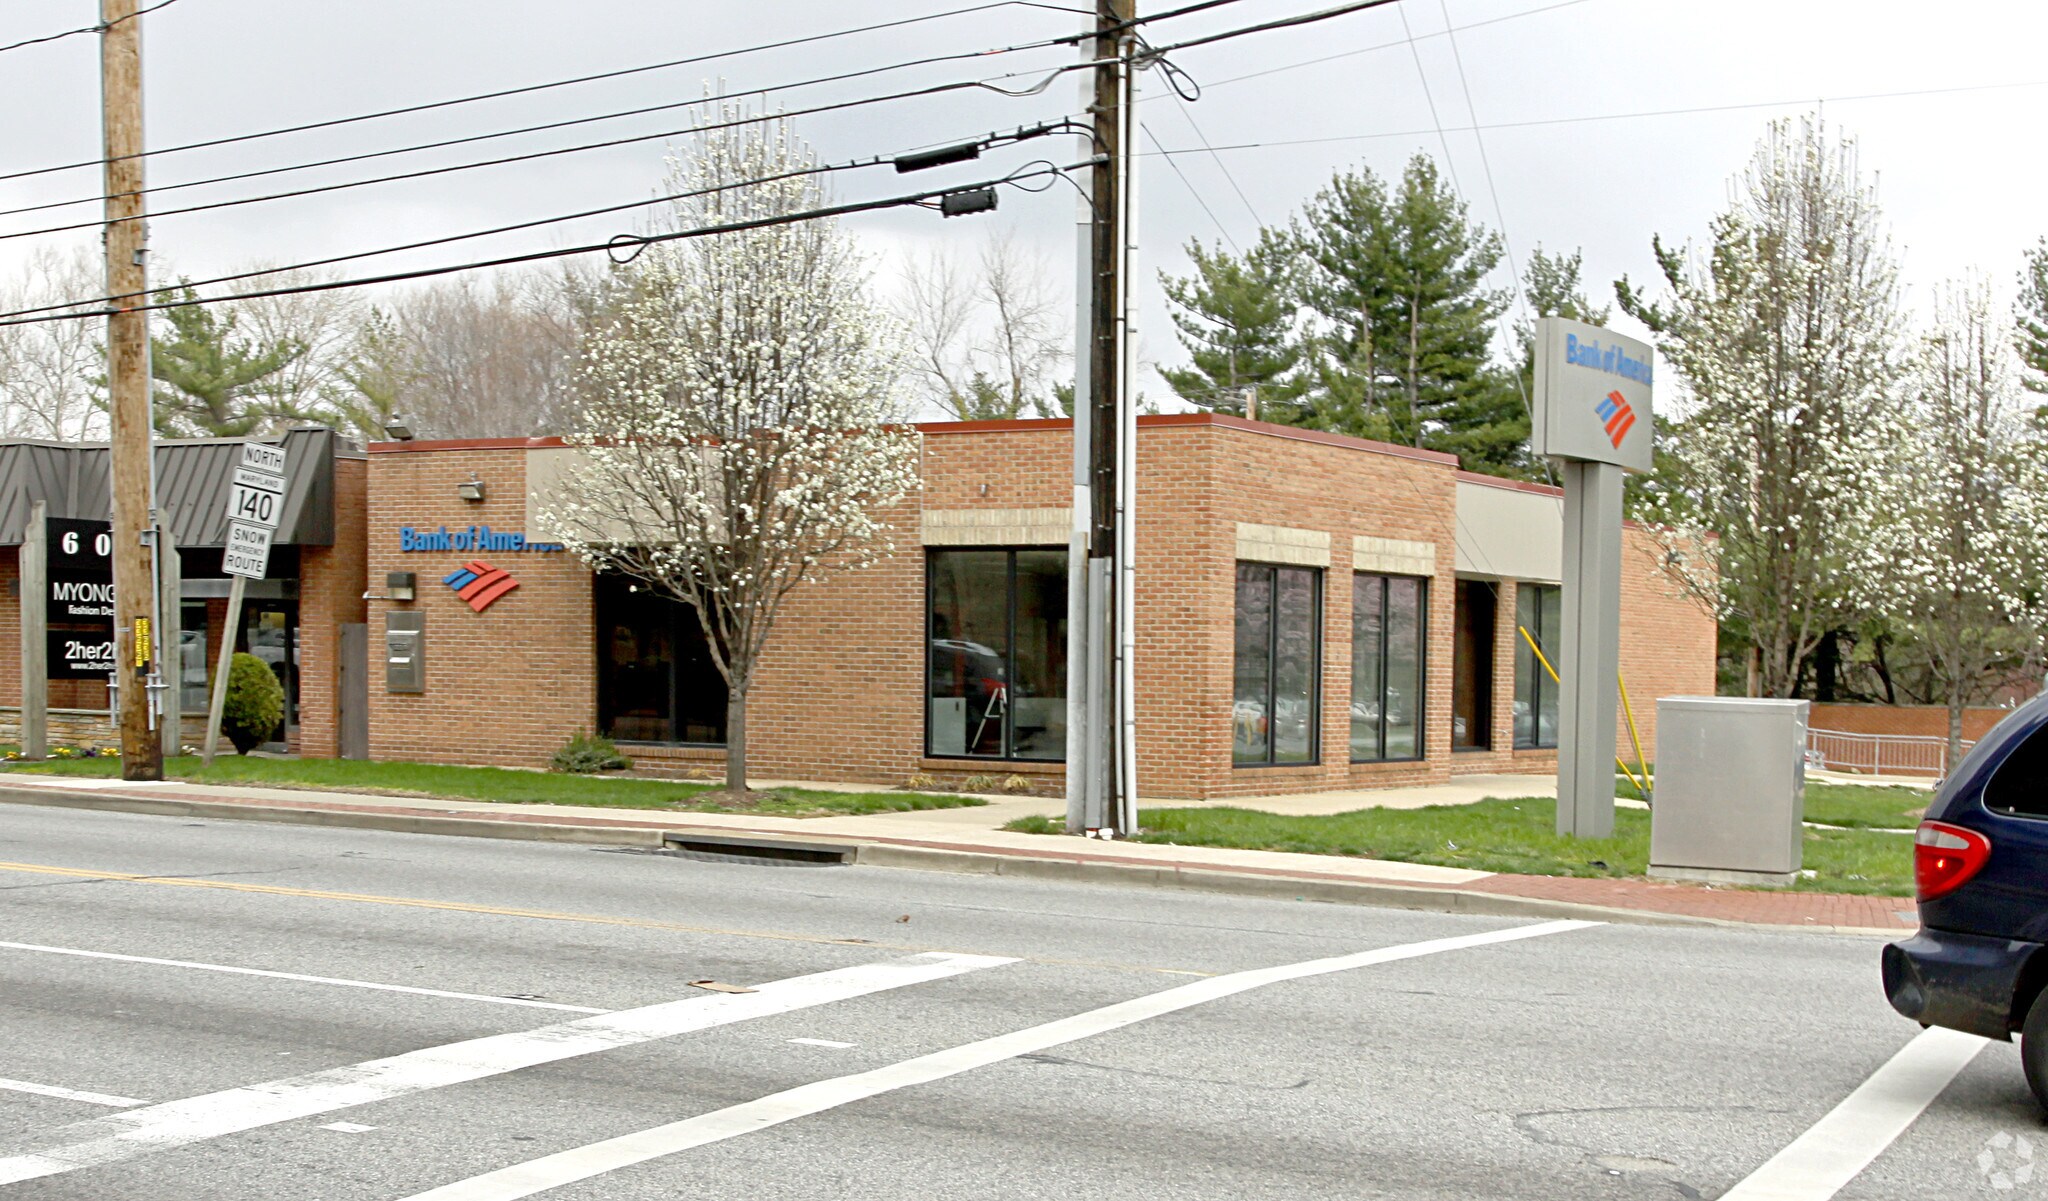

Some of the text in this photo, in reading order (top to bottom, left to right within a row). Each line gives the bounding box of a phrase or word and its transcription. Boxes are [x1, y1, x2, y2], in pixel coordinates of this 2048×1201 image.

[1566, 333, 1602, 370] Bank
[1603, 344, 1616, 374] of
[244, 447, 282, 469] NORTH
[240, 474, 280, 488] MARYLAND
[237, 489, 273, 521] 140
[233, 528, 267, 545] SNOW
[400, 526, 451, 552] Bank
[454, 525, 477, 551] of
[230, 543, 265, 556] EMERGENCY
[226, 554, 263, 573] ROUTE
[53, 582, 115, 603] MYONG
[68, 604, 115, 617] Fashion De
